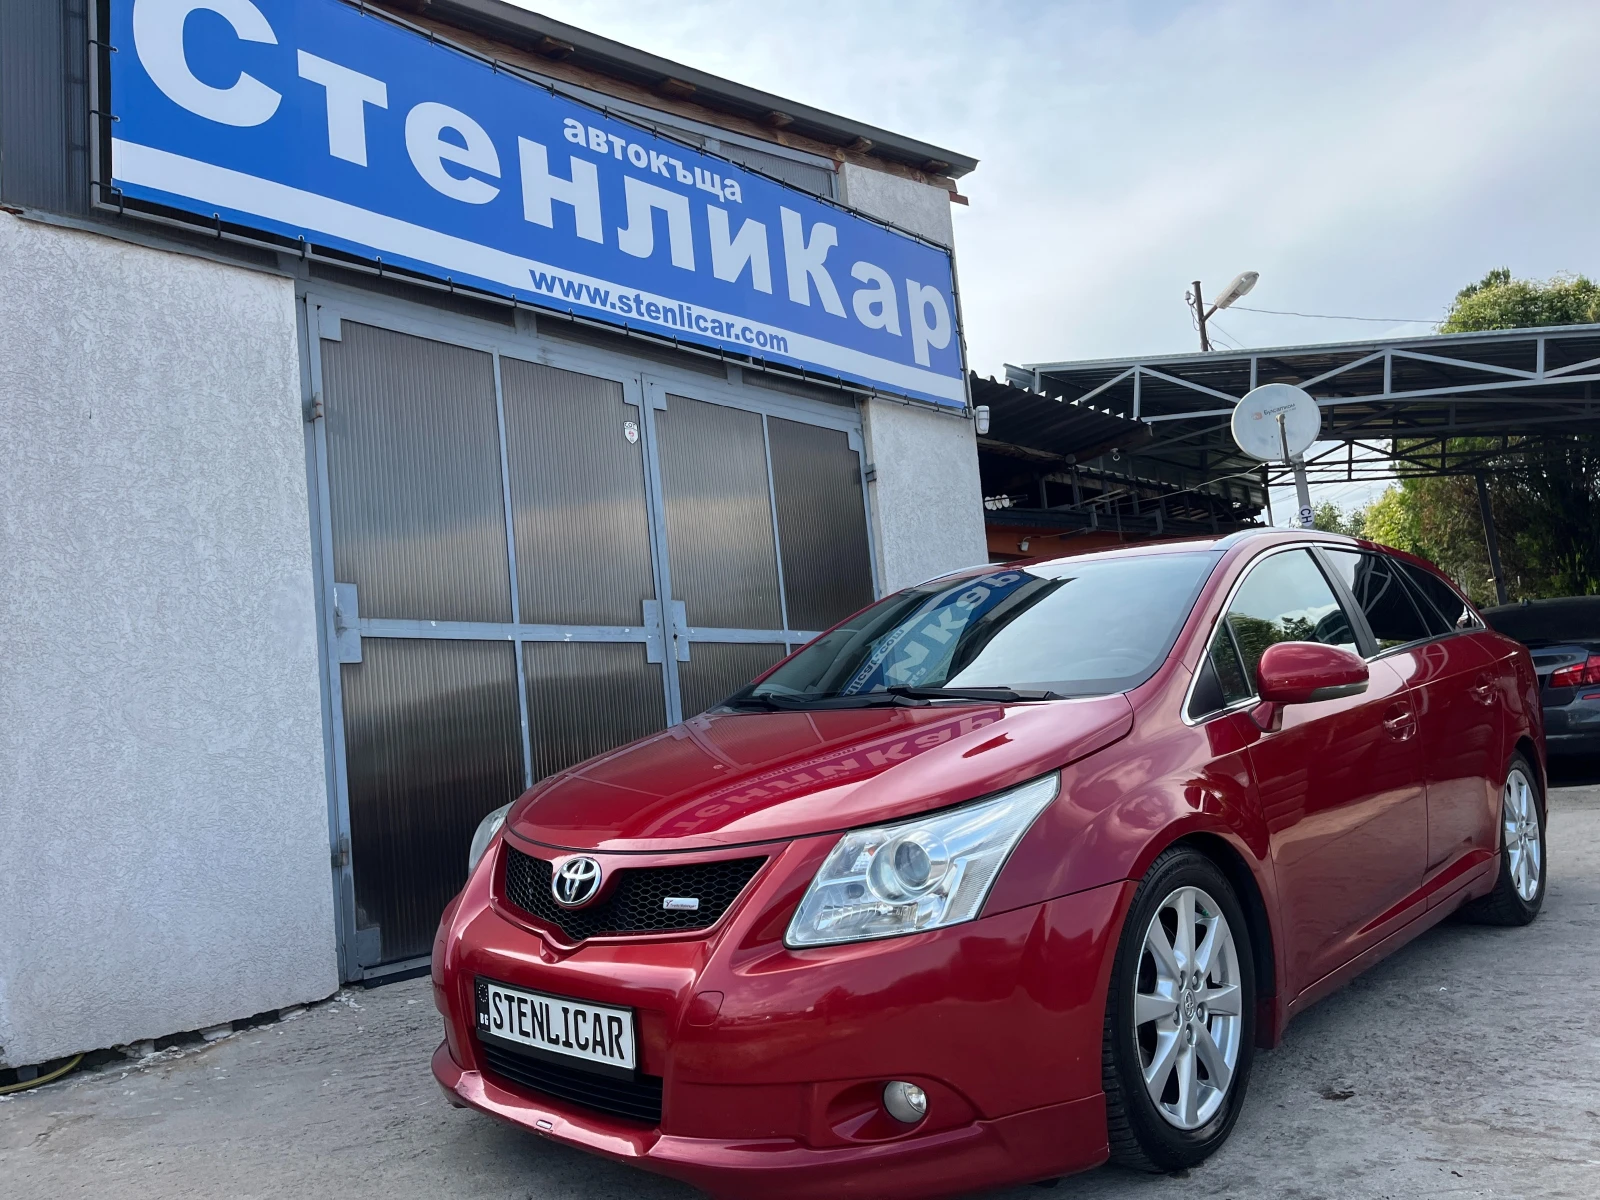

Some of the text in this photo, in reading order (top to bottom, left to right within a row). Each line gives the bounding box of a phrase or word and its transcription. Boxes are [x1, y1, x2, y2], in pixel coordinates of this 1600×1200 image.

[132, 0, 952, 367] СтенлиКар
[563, 117, 742, 203] автокъща
[529, 269, 789, 353] www.stenlicar.com
[479, 1011, 489, 1026] BG
[492, 991, 625, 1060] STENLICAR
